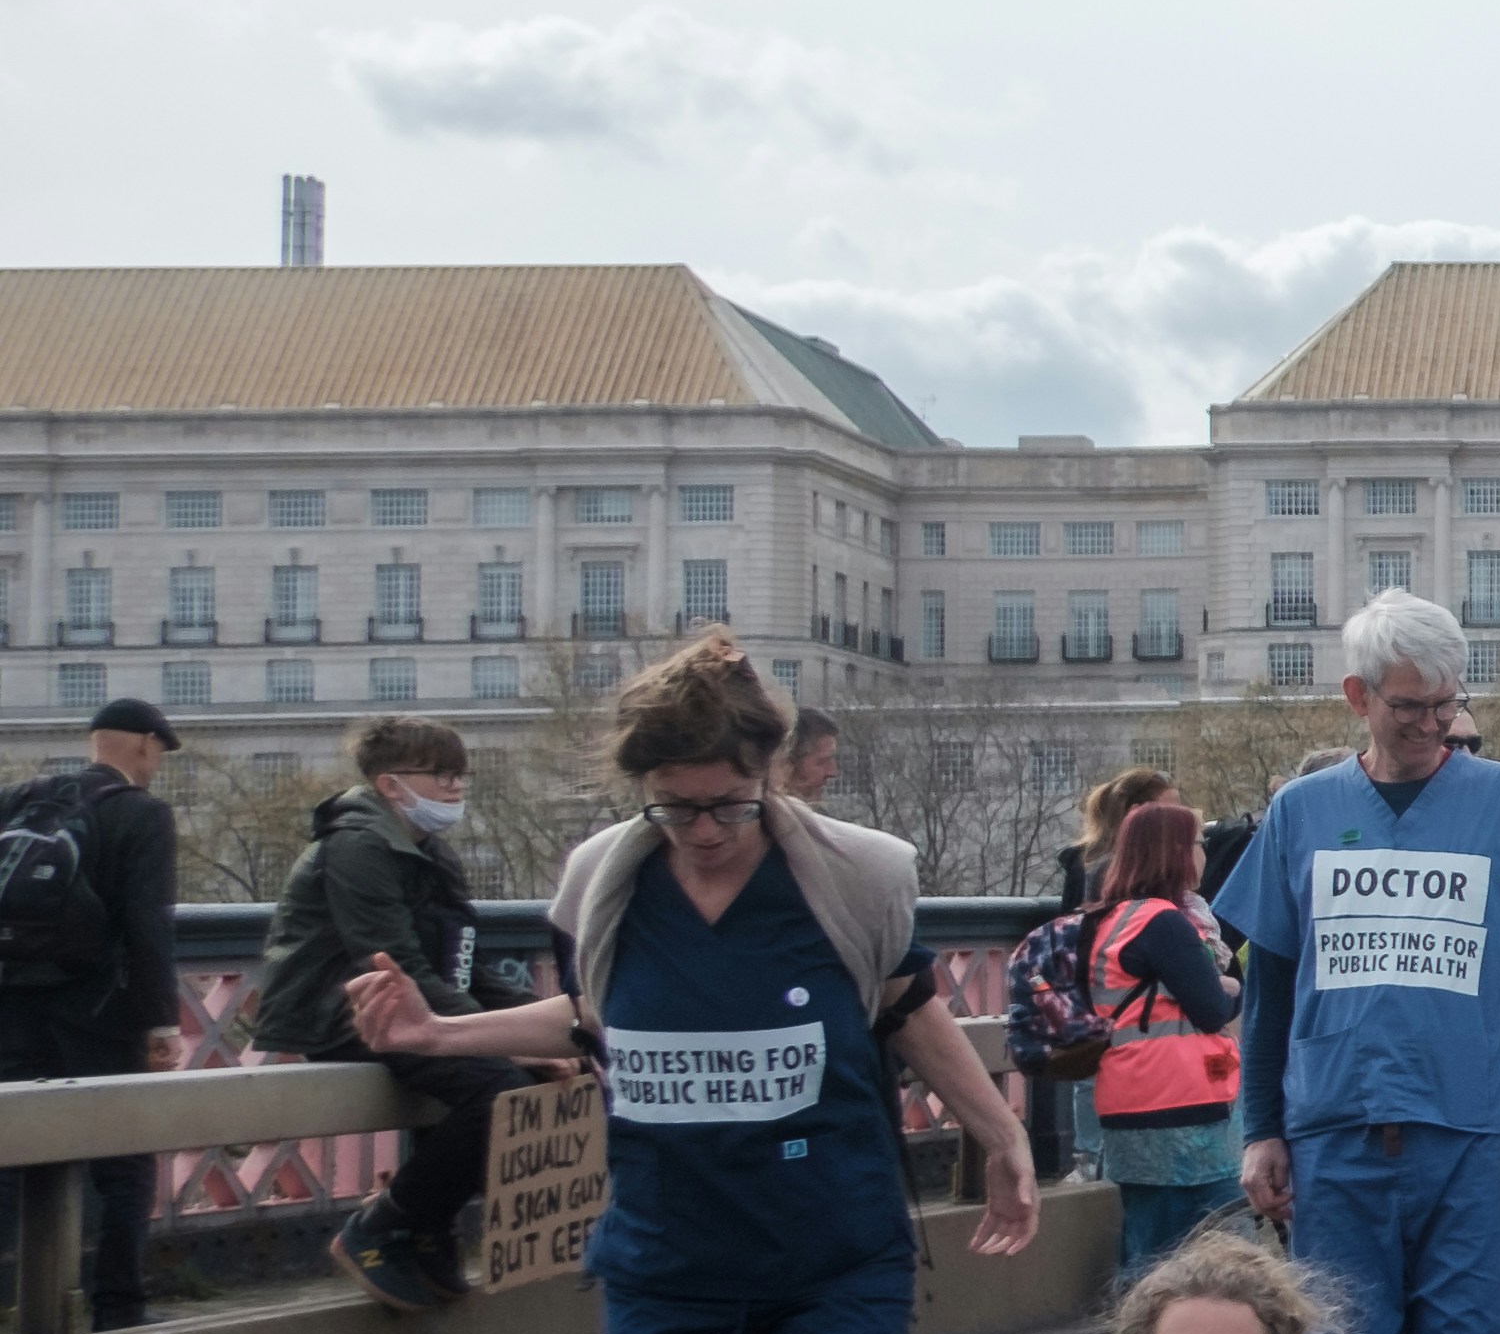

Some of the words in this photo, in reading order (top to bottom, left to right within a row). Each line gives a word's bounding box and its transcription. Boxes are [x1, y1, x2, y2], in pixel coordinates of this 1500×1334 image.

[1332, 867, 1468, 901] DOCTOR
[1321, 932, 1436, 952] PROTESTING
[1443, 935, 1478, 958] FOR
[1329, 954, 1389, 975] PUBLIC
[1396, 954, 1467, 979] HEALTH
[767, 1043, 817, 1071] FOR
[556, 1083, 596, 1126] NOT
[620, 1079, 696, 1104] PUBLIC
[705, 1074, 805, 1104] HEALTH
[501, 1133, 591, 1186] USUALLY
[511, 1187, 561, 1230] SIGN
[568, 1173, 606, 1210] GUY
[489, 1233, 540, 1282] BUT
